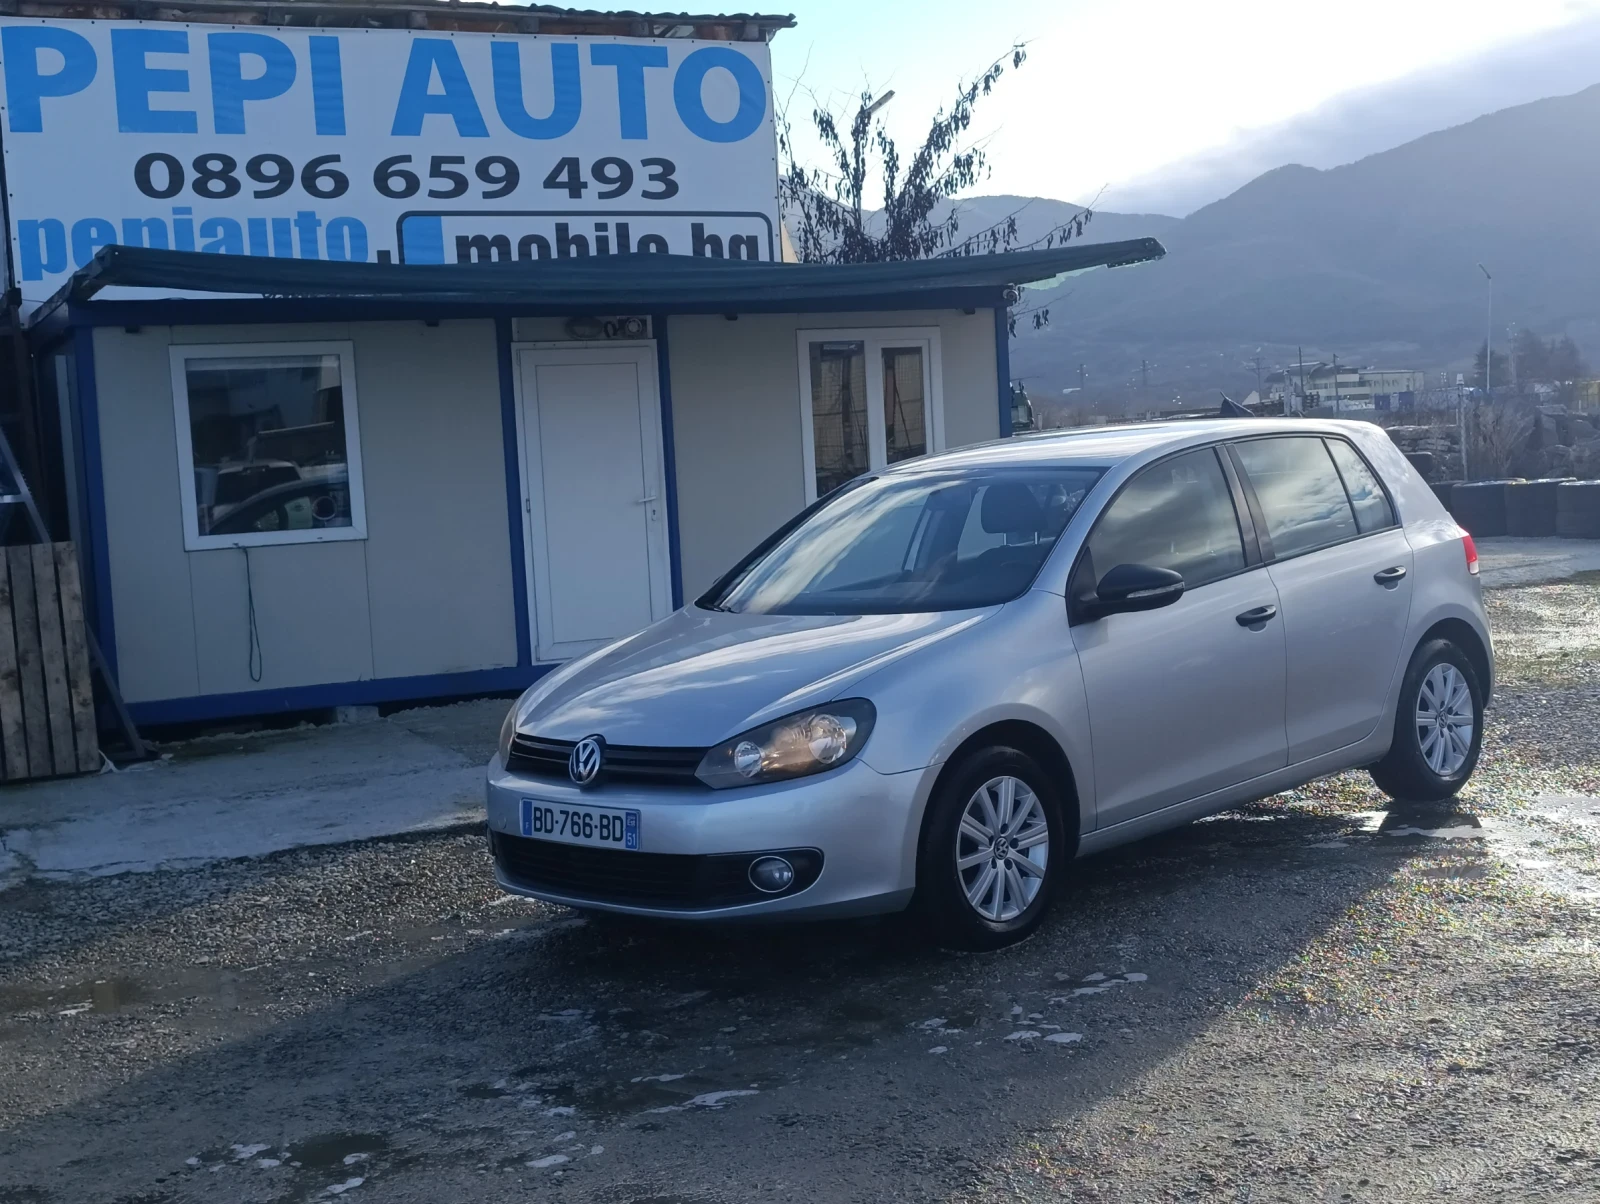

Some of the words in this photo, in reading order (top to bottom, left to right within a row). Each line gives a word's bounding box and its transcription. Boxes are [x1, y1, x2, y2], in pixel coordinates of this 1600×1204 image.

[1, 26, 347, 136] PEPI
[391, 37, 767, 143] AUTO
[134, 152, 350, 199] 0896
[373, 154, 520, 200] 659
[542, 156, 679, 200] 493
[533, 806, 624, 842] BD-766-BD
